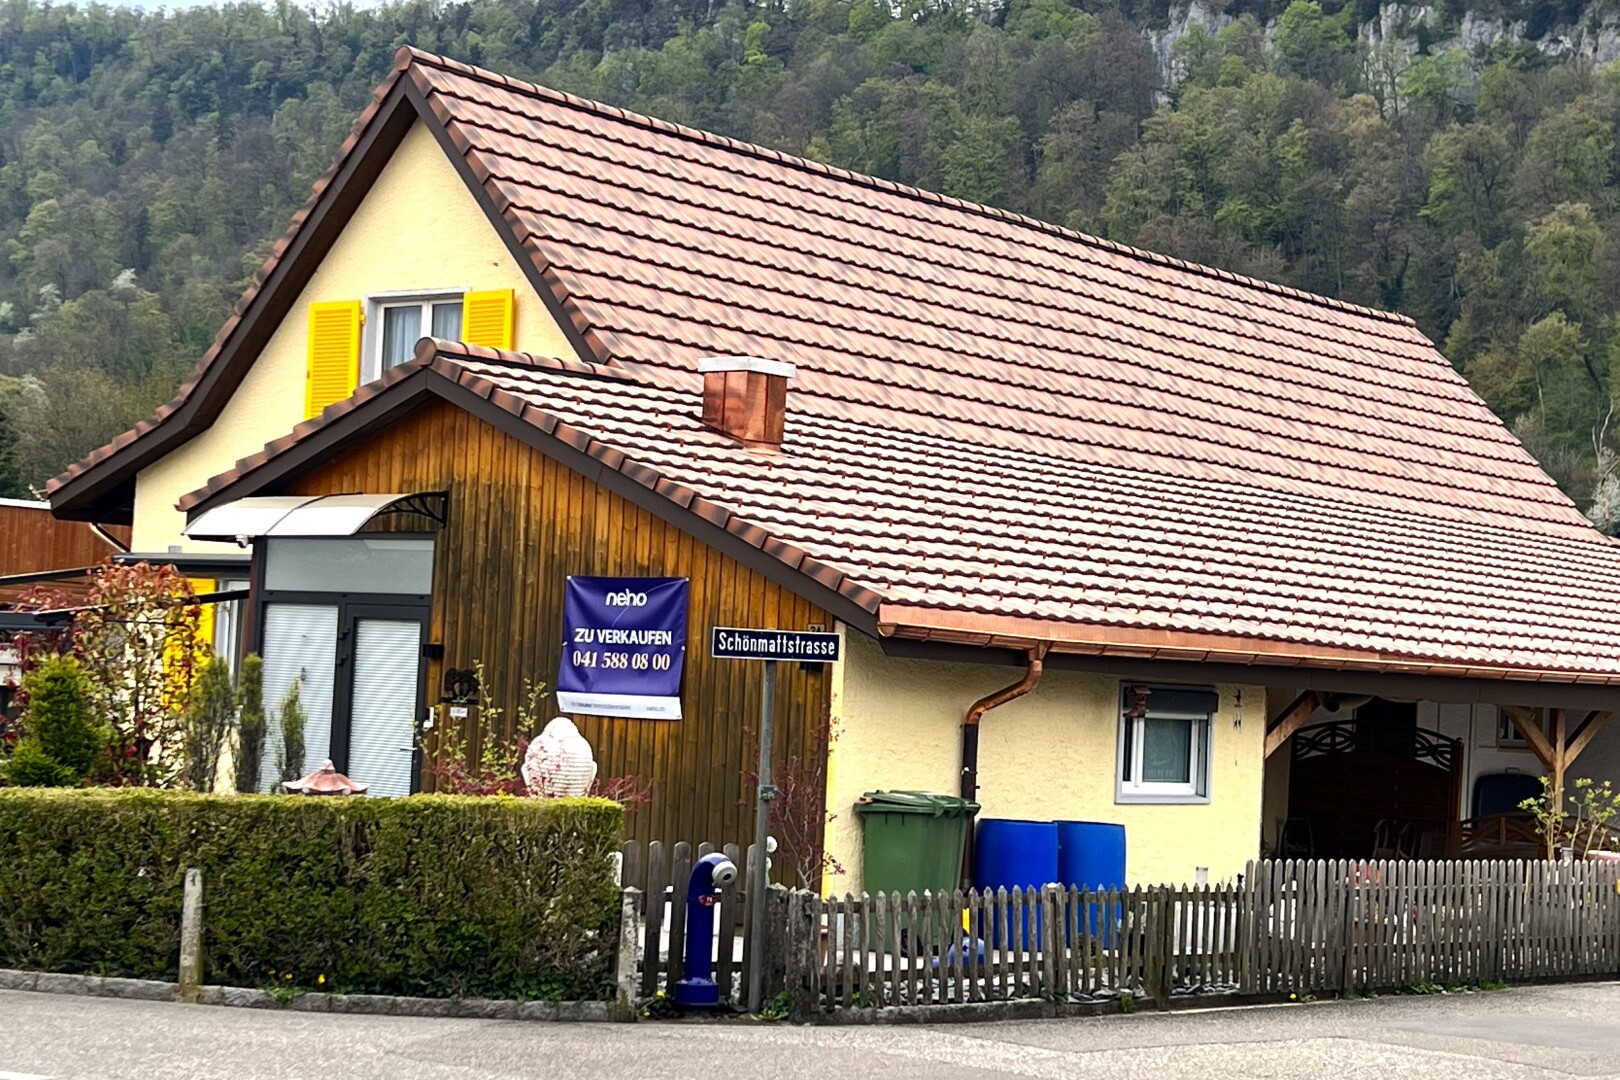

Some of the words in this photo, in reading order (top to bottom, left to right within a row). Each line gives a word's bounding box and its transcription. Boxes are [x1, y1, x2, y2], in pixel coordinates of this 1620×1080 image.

[605, 588, 647, 606] neho
[574, 628, 594, 642] ZU
[597, 629, 672, 645] VERKAUFEN
[718, 632, 835, 655] Schönmattstrasse
[573, 650, 598, 667] 041
[601, 652, 628, 669] 588
[632, 653, 649, 670] 08
[652, 653, 670, 670] 00
